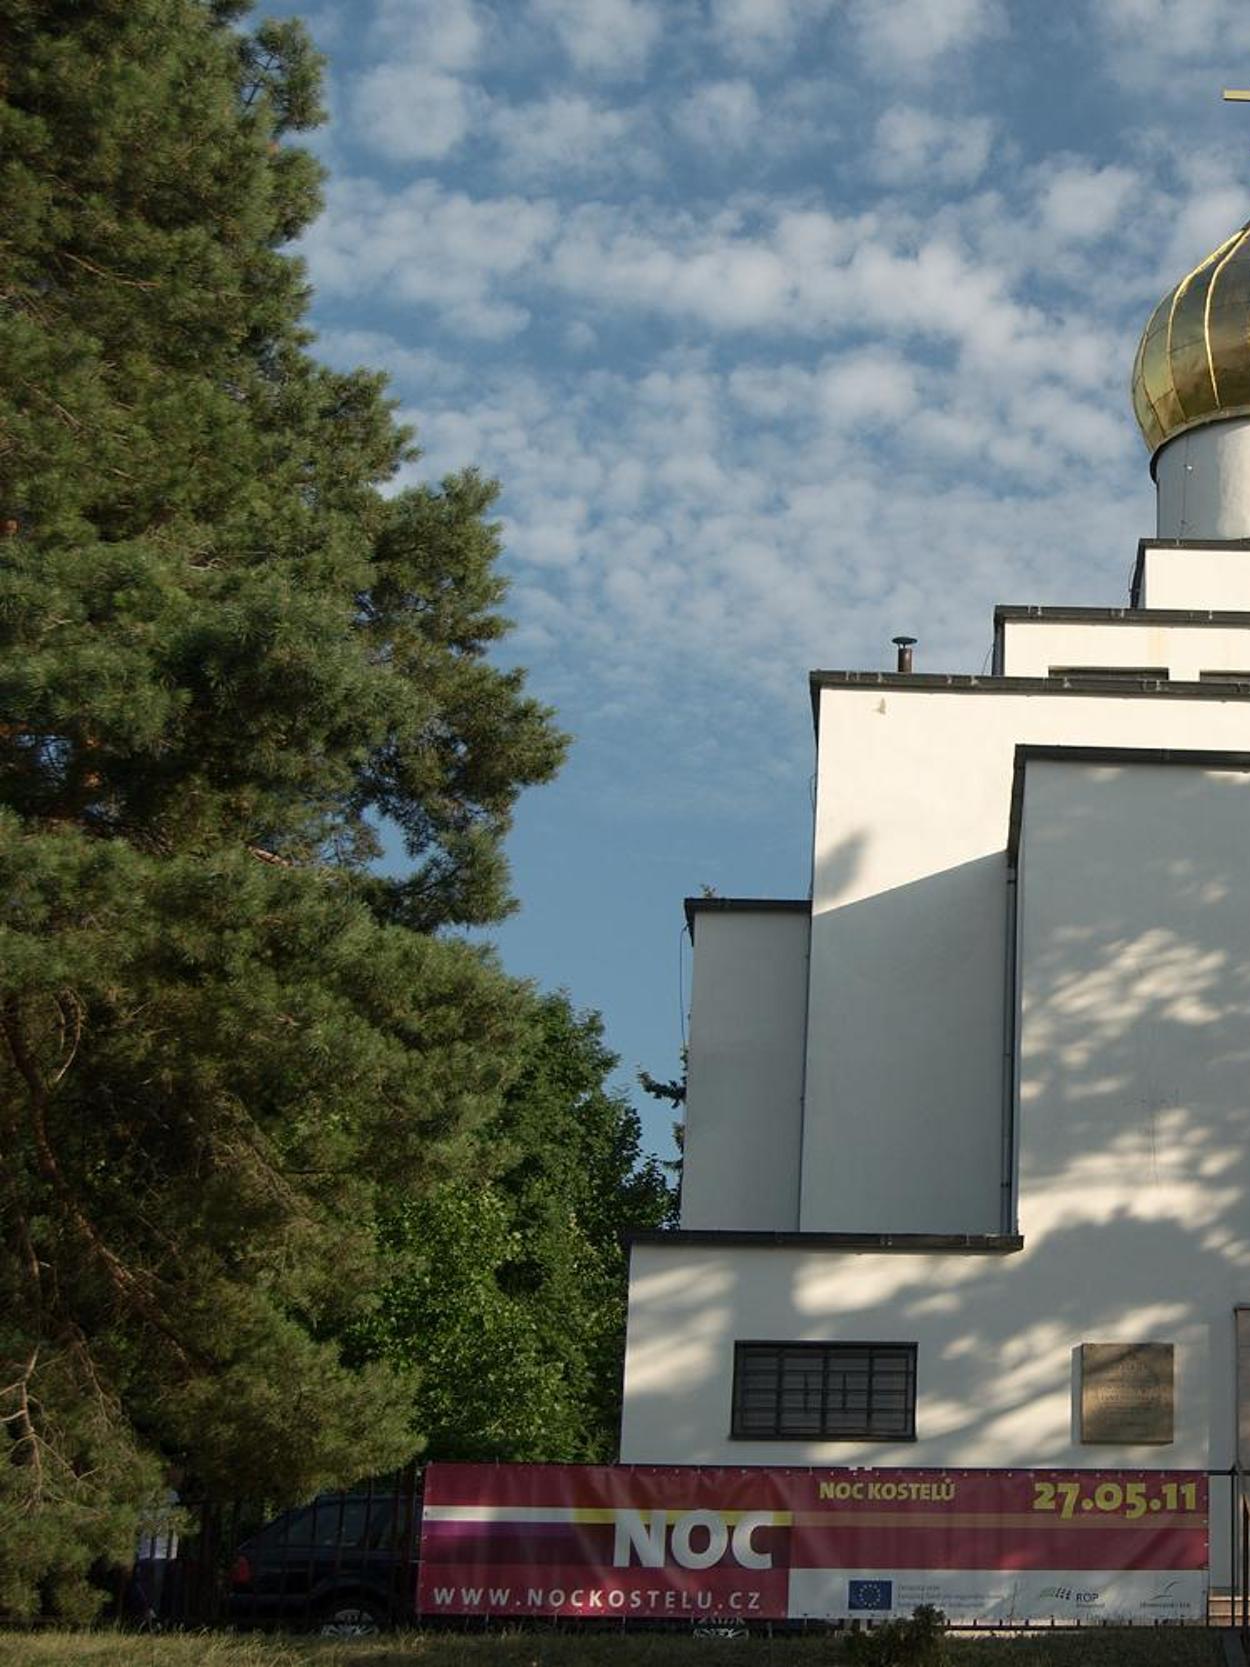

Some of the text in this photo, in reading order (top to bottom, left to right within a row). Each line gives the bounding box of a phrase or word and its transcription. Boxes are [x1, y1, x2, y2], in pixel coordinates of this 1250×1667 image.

[819, 1481, 863, 1500] NOC
[1033, 1482, 1197, 1519] 27.05.11
[613, 1509, 773, 1569] NOC
[433, 1587, 761, 1610] WWW.NOCKOSTELU.CZ
